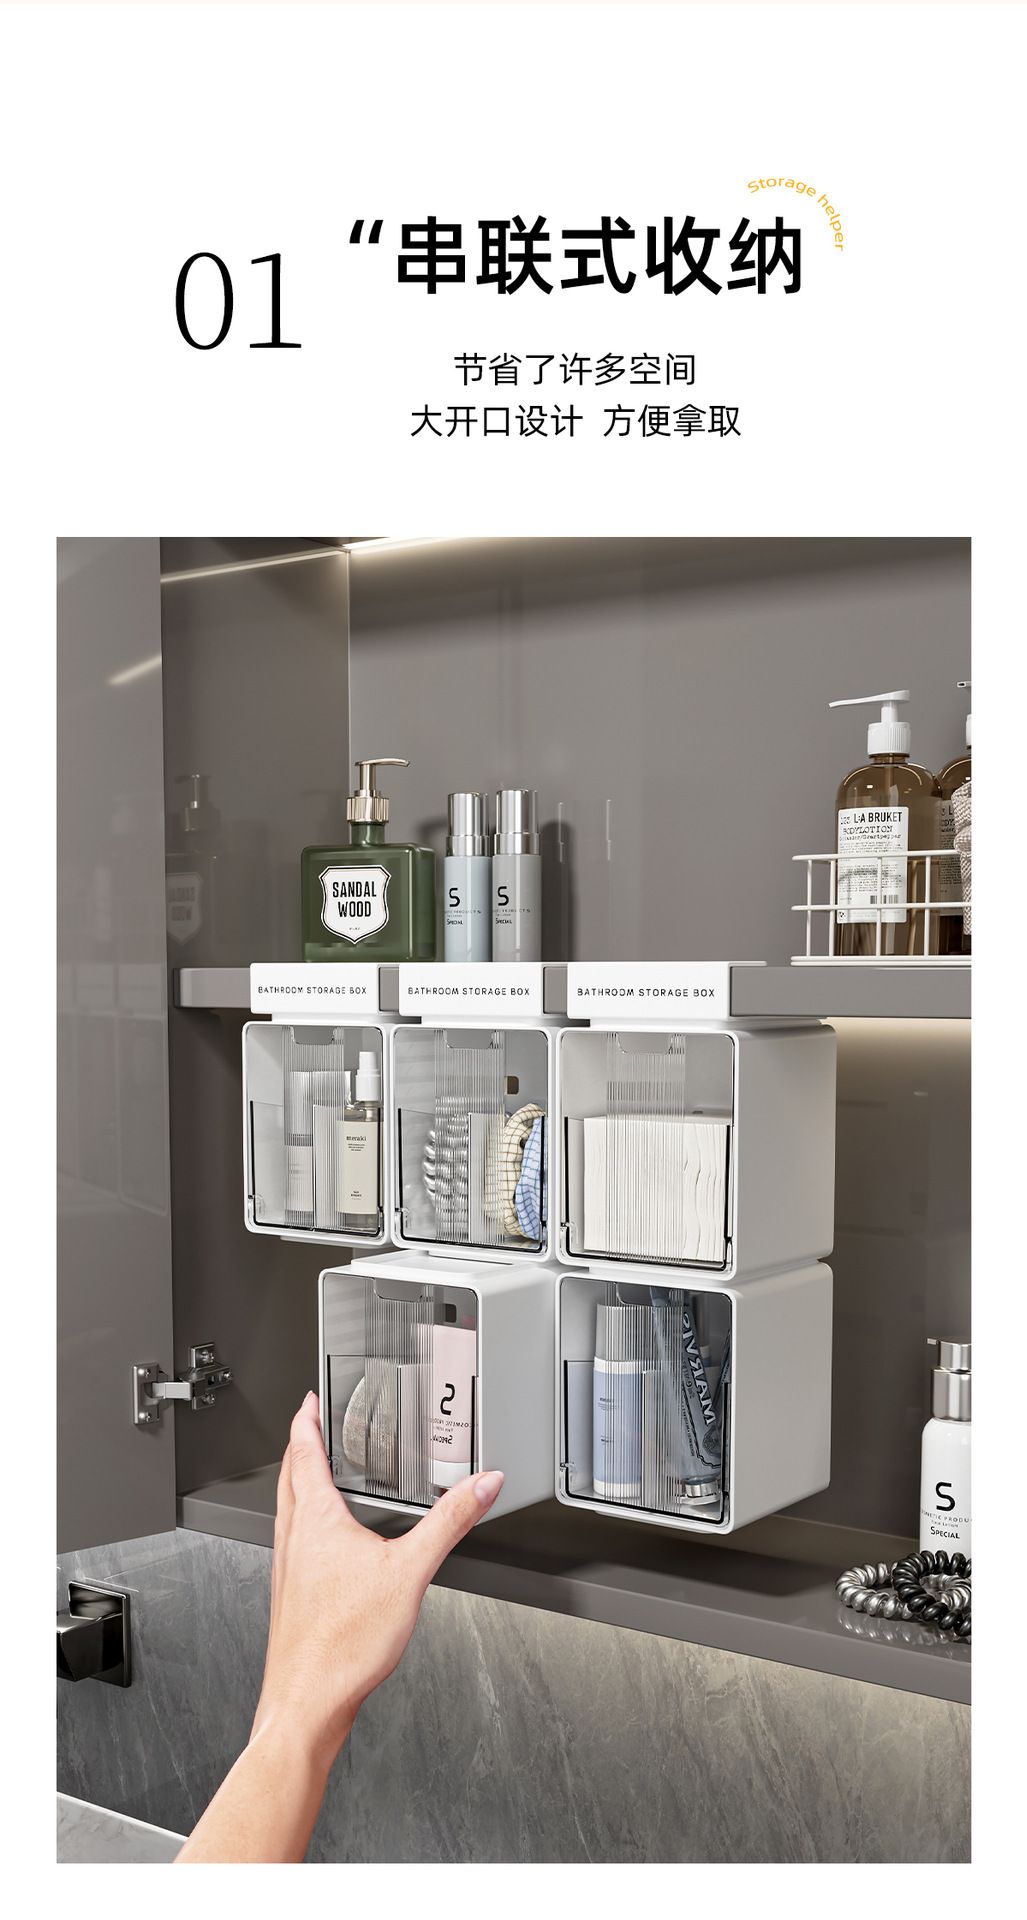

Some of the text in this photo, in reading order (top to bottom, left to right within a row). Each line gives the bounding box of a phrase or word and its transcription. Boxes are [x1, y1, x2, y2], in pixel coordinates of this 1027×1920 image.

[868, 812, 903, 823] BRUKET
[332, 881, 377, 898] SANDAL
[448, 887, 460, 907] S
[497, 886, 509, 906] S
[337, 901, 372, 918] WOOD
[258, 986, 367, 995] BATHROOM STORAGE BOX
[408, 987, 530, 996] BATHROOM STORAGE BOX
[577, 988, 715, 998] BATHROOM STORAGE BOX
[935, 1481, 956, 1512] S
